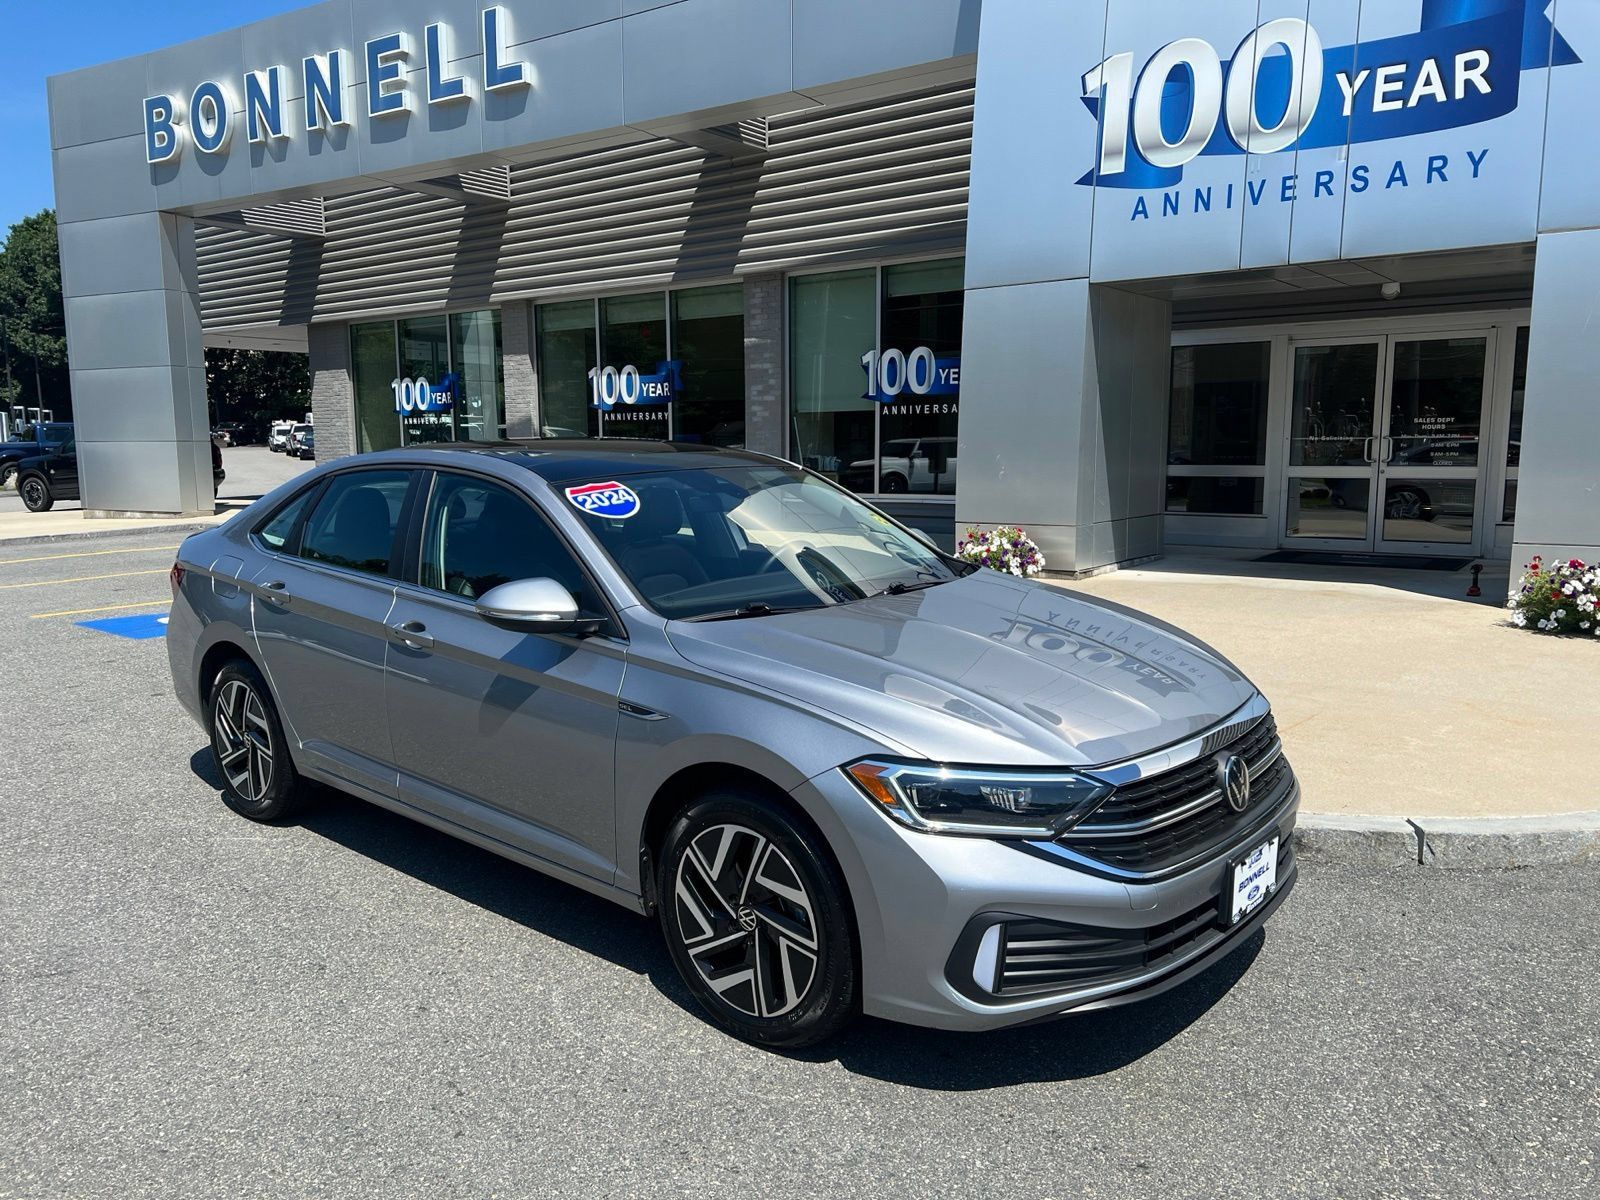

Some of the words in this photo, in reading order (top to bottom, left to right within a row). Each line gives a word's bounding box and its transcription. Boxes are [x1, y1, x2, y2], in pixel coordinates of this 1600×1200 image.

[143, 4, 532, 163] BONNELL
[1081, 18, 1323, 176] 100
[1335, 49, 1491, 117] YEAR
[1130, 149, 1489, 221] ANNIVERSARY
[588, 364, 640, 405] 100
[641, 382, 670, 397] YEAR
[861, 346, 936, 396] 100
[939, 368, 960, 385] YE
[391, 376, 430, 411] 100
[431, 391, 453, 404] YEAR
[883, 403, 959, 415] ANNIVERSA
[404, 416, 451, 425] ANNIVERSA
[604, 412, 669, 421] ANNIVERSARY
[577, 489, 635, 510] 2024
